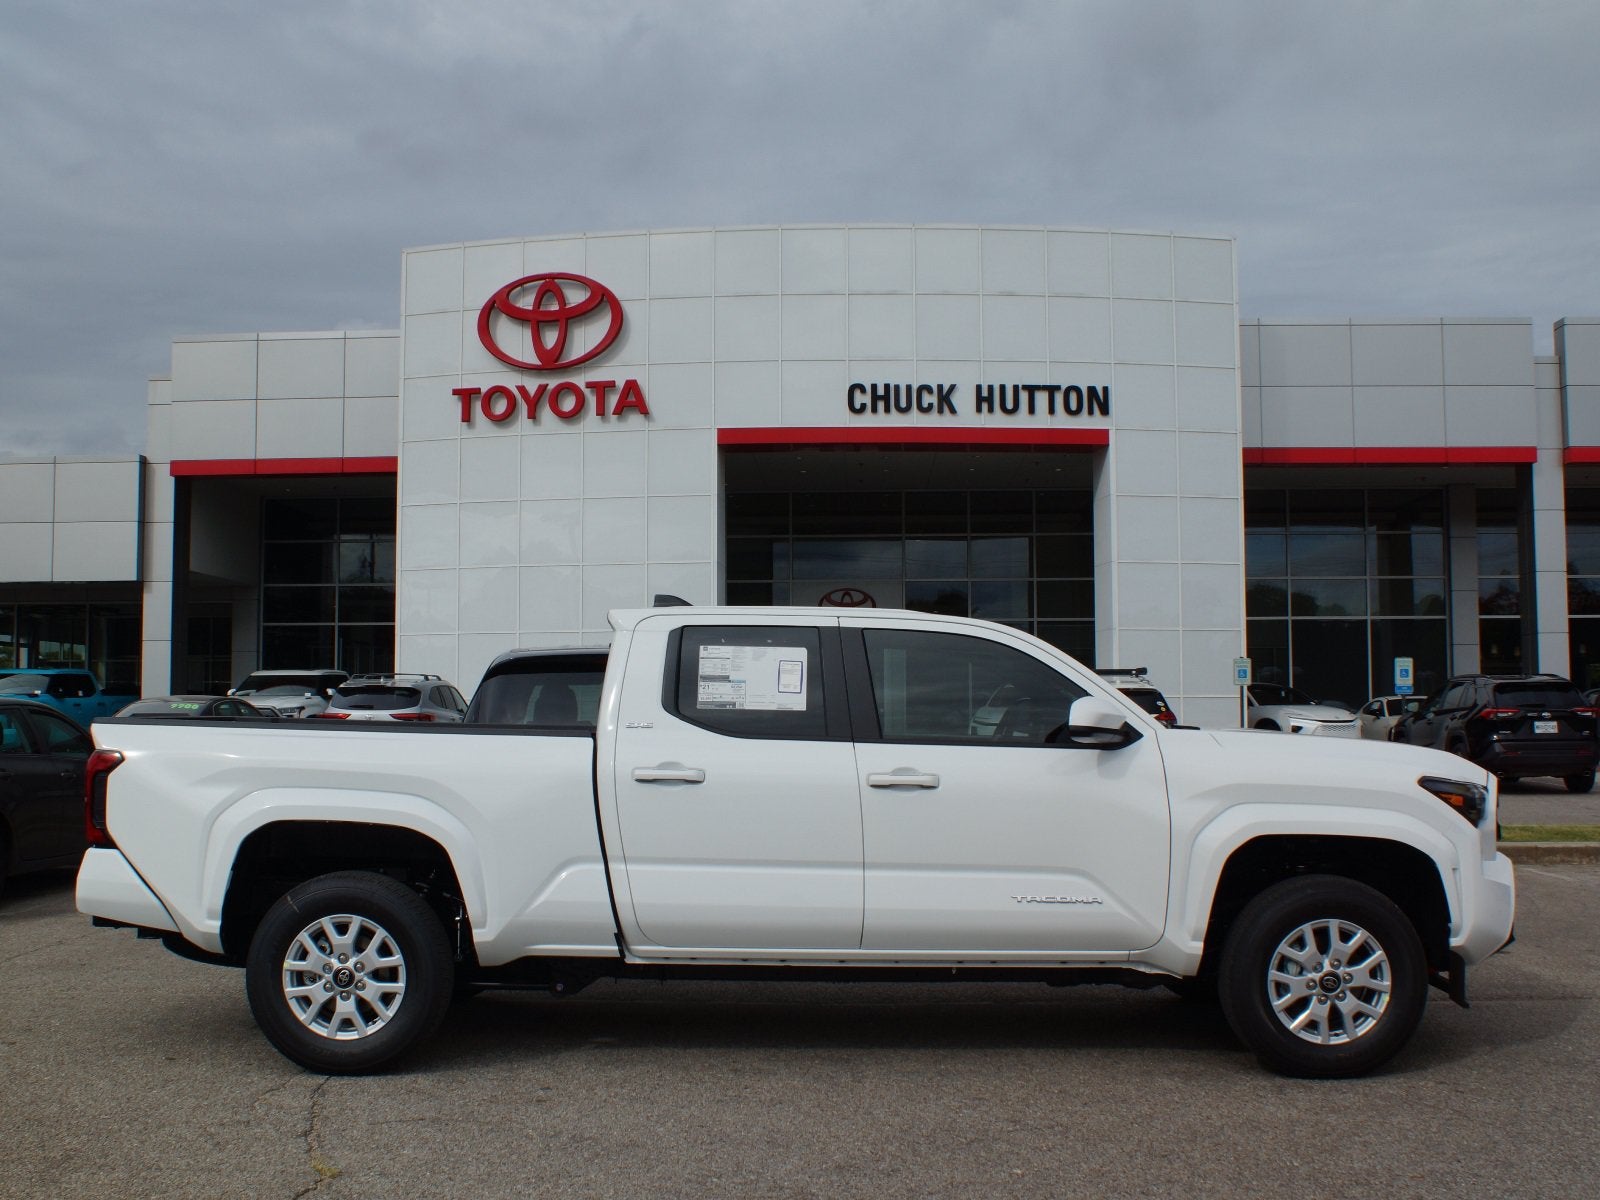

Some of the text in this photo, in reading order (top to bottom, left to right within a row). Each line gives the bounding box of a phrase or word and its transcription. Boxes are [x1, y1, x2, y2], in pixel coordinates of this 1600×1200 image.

[452, 379, 650, 423] TOYOTA
[848, 383, 1110, 416] CHUCK HUTTON
[1011, 895, 1103, 904] TACOMA
